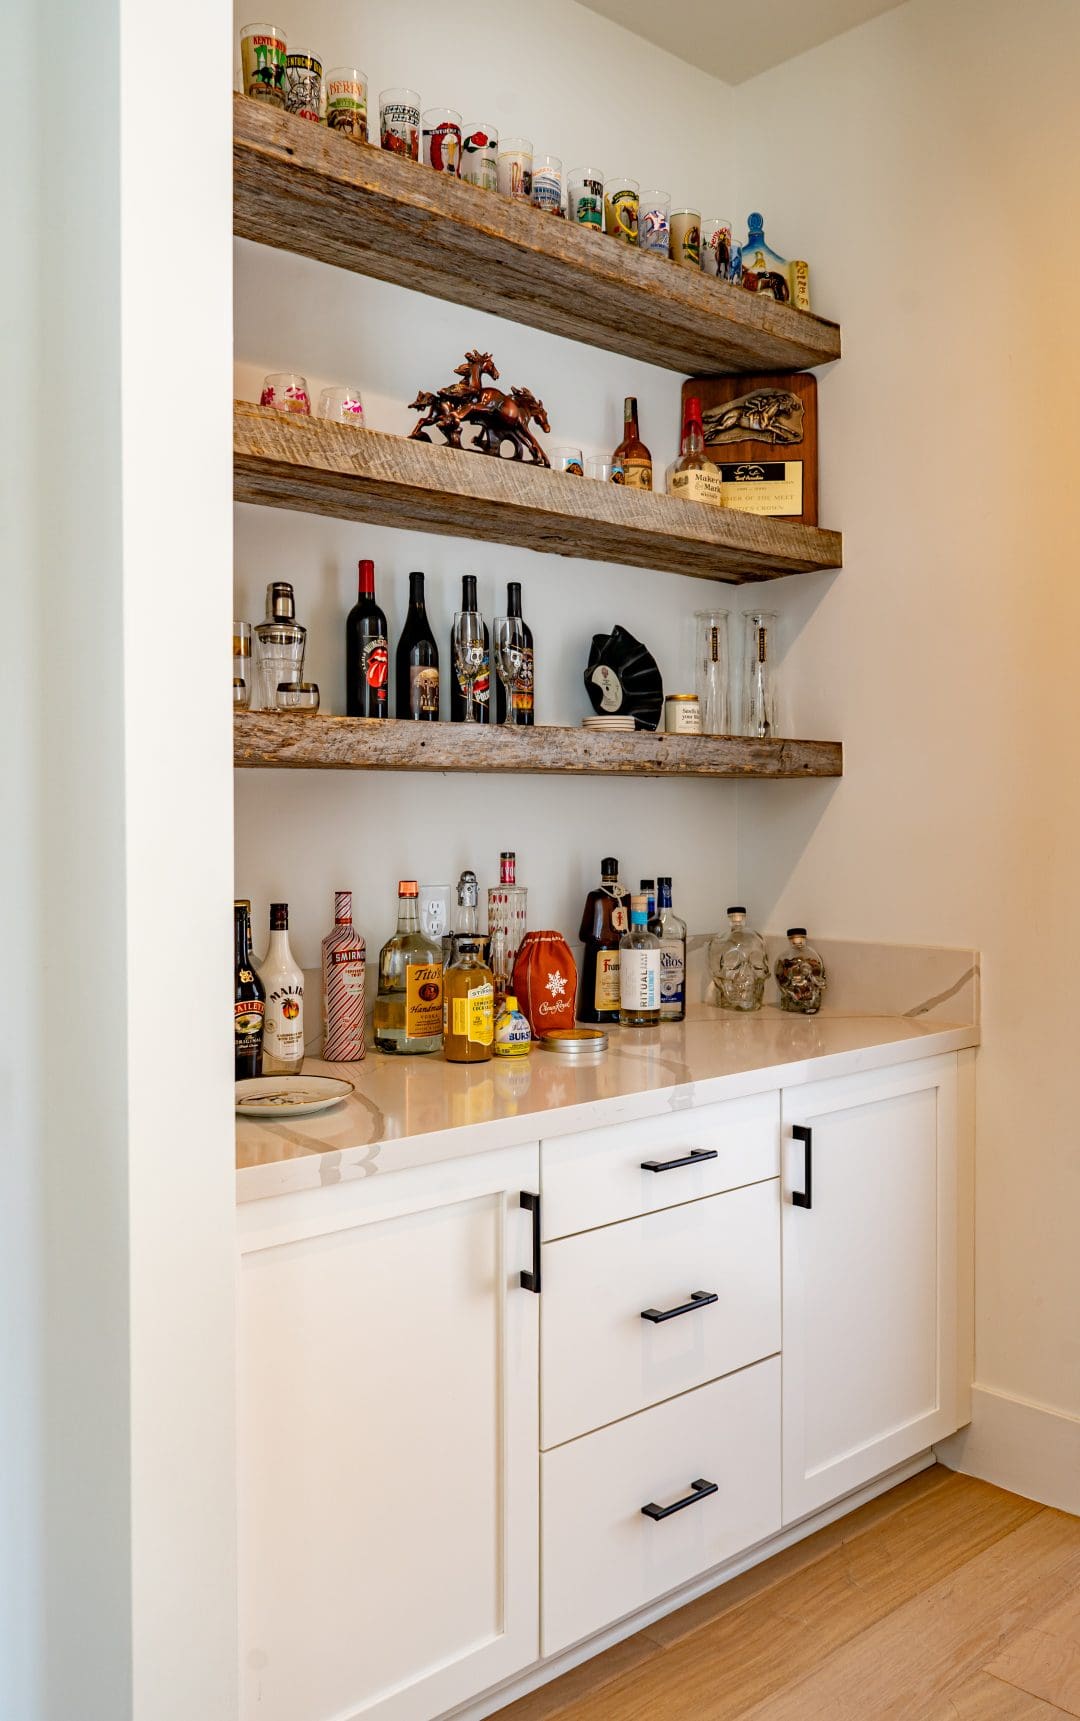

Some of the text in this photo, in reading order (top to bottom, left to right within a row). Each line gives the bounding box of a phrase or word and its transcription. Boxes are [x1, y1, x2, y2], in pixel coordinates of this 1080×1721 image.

[704, 483, 721, 493] Mark
[640, 970, 648, 1007] RITUAL
[509, 1031, 531, 1040] BURST
